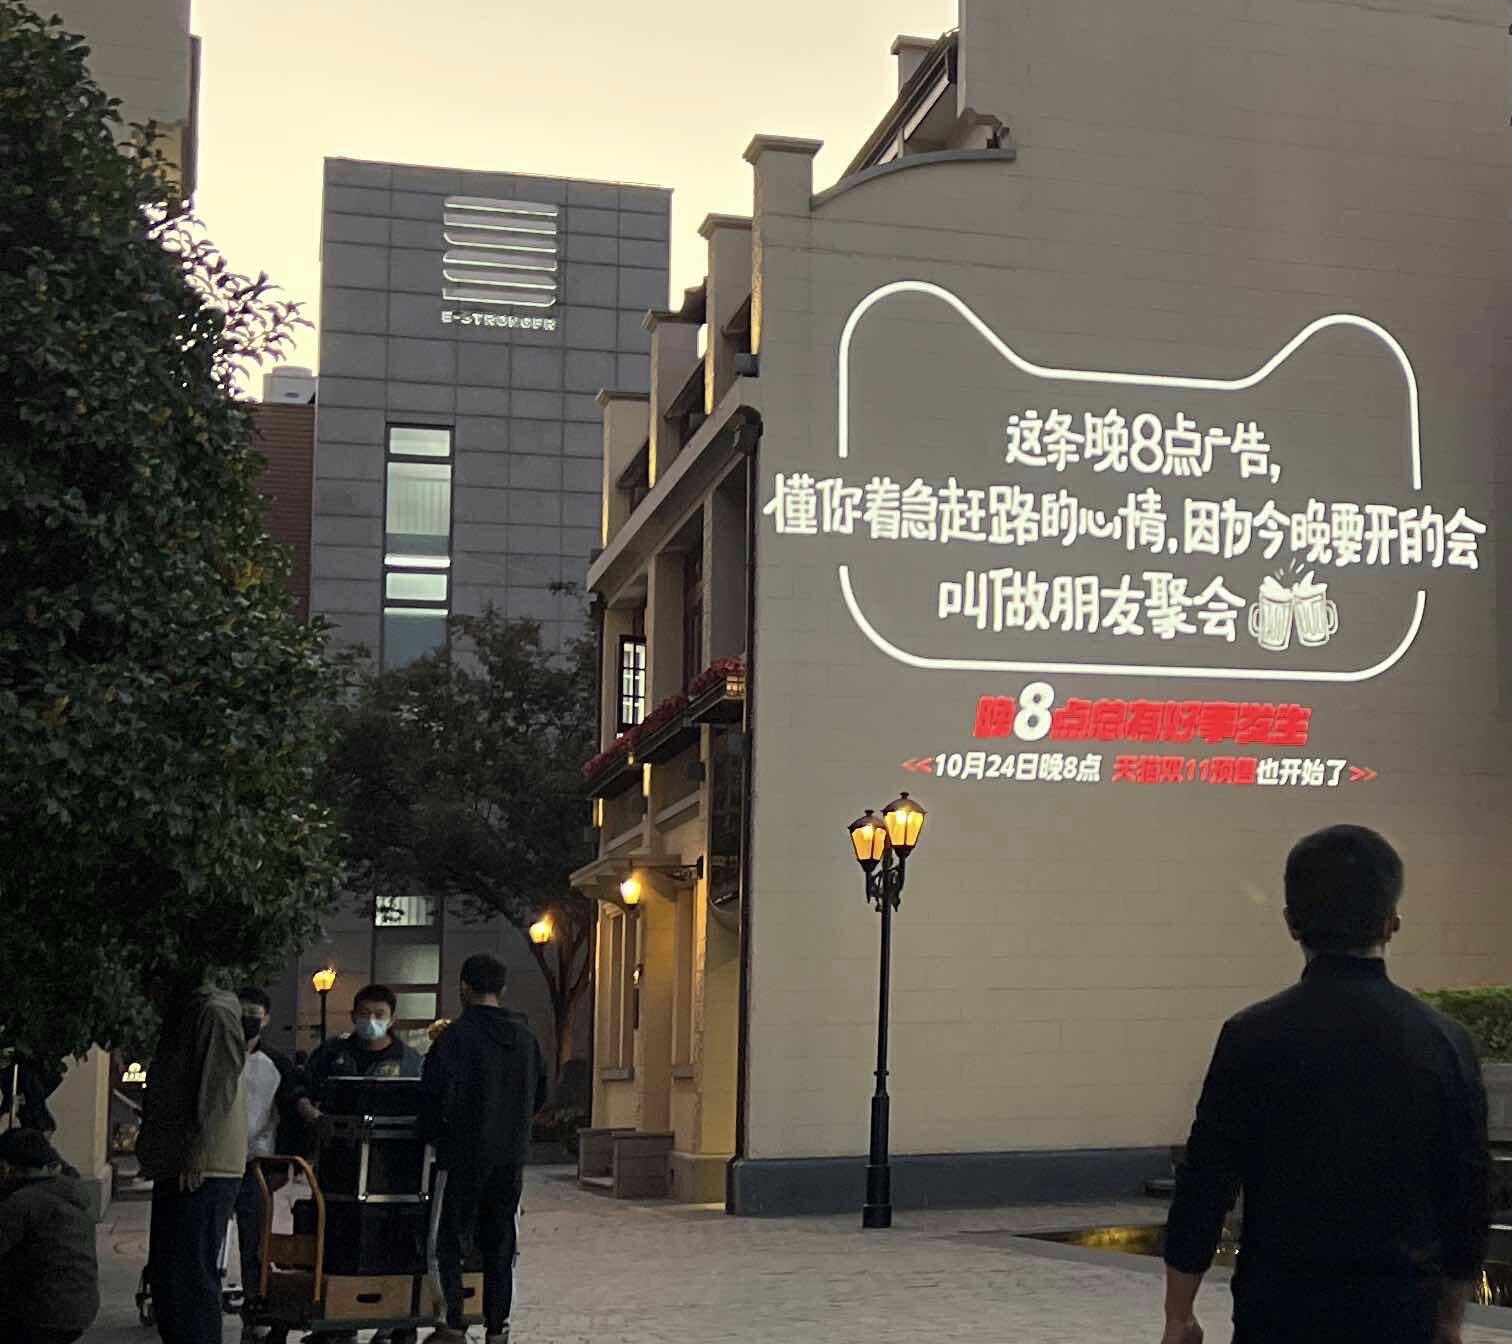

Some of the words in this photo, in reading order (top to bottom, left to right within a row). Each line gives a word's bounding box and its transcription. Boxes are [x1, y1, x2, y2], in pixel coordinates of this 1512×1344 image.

[938, 567, 1247, 642] 叫做朋友聚会
[935, 751, 1102, 782] 10月24日晚8点
